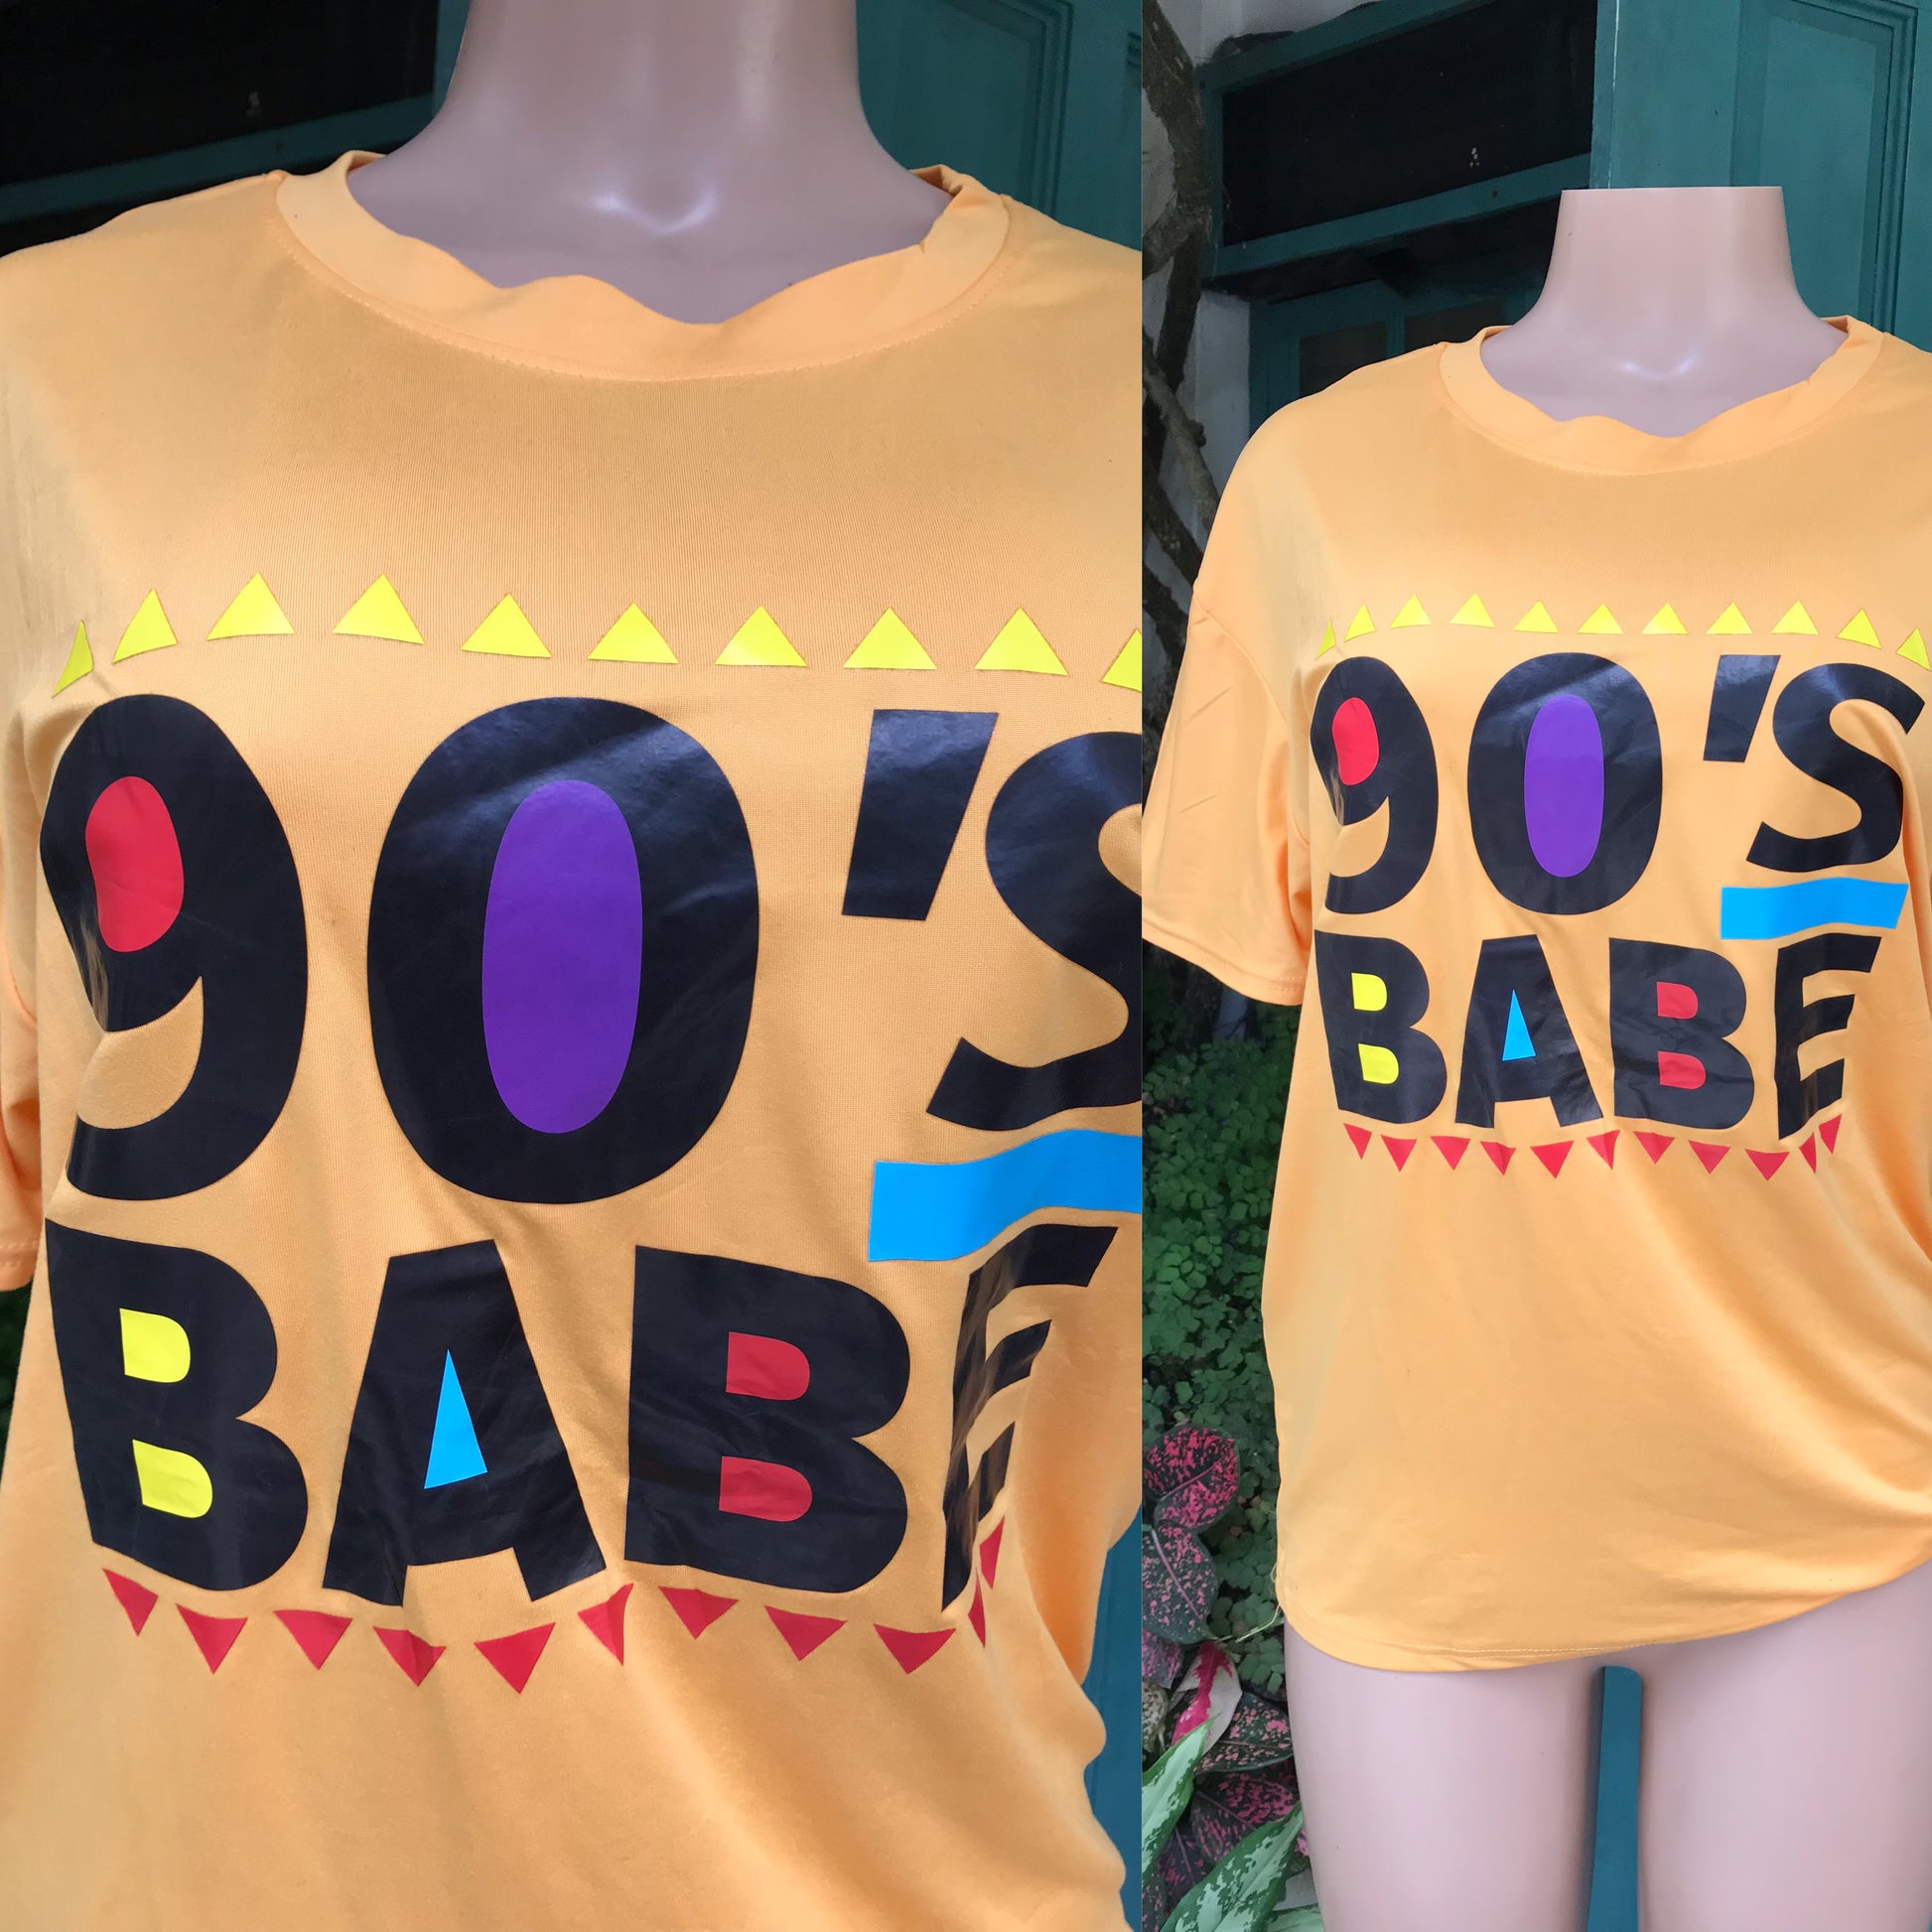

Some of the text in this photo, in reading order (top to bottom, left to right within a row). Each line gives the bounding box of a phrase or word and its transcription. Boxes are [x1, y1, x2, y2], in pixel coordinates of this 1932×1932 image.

[1310, 652, 1926, 915] 90'S
[1314, 929, 1881, 1140] BABE
[45, 1218, 1119, 1611] BABE
